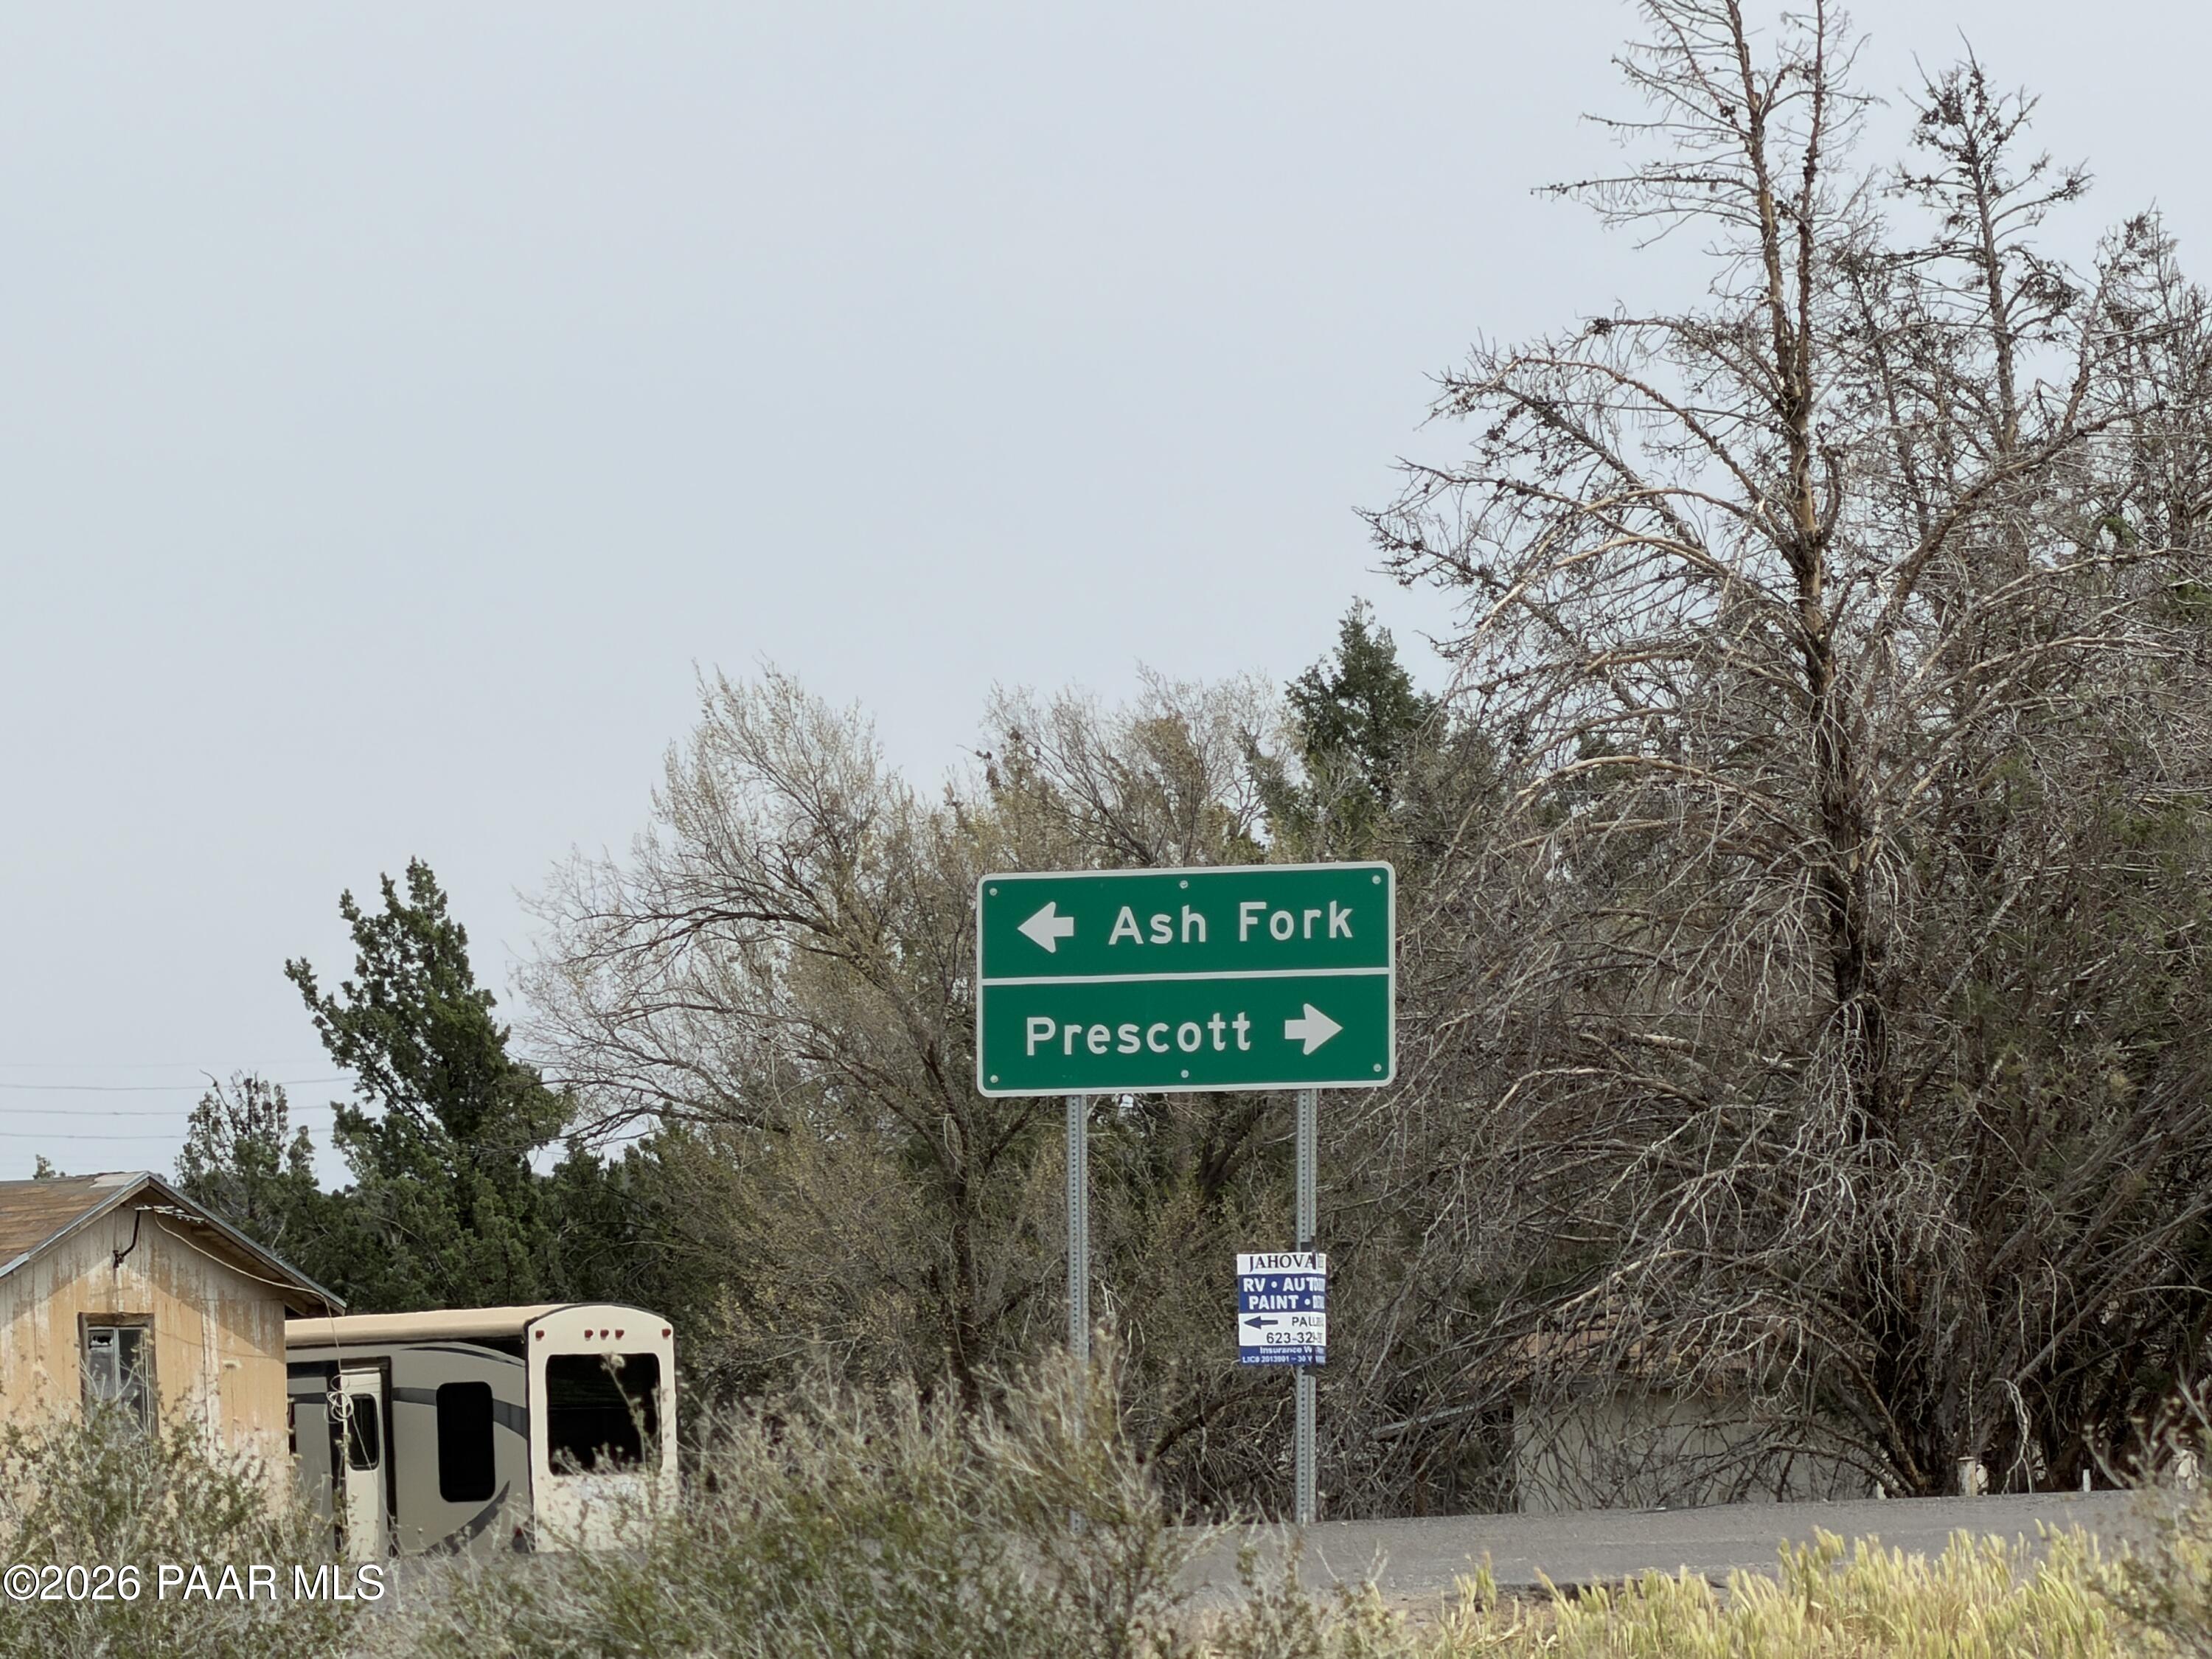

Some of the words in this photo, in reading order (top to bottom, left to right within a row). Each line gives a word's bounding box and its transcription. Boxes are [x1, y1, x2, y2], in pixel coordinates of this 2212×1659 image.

[1108, 905, 1206, 945] Ash
[1239, 900, 1353, 942] Fork
[1026, 1012, 1251, 1057] Prescott
[1243, 1278, 1266, 1293] RV
[1249, 1295, 1299, 1310] PAINT
